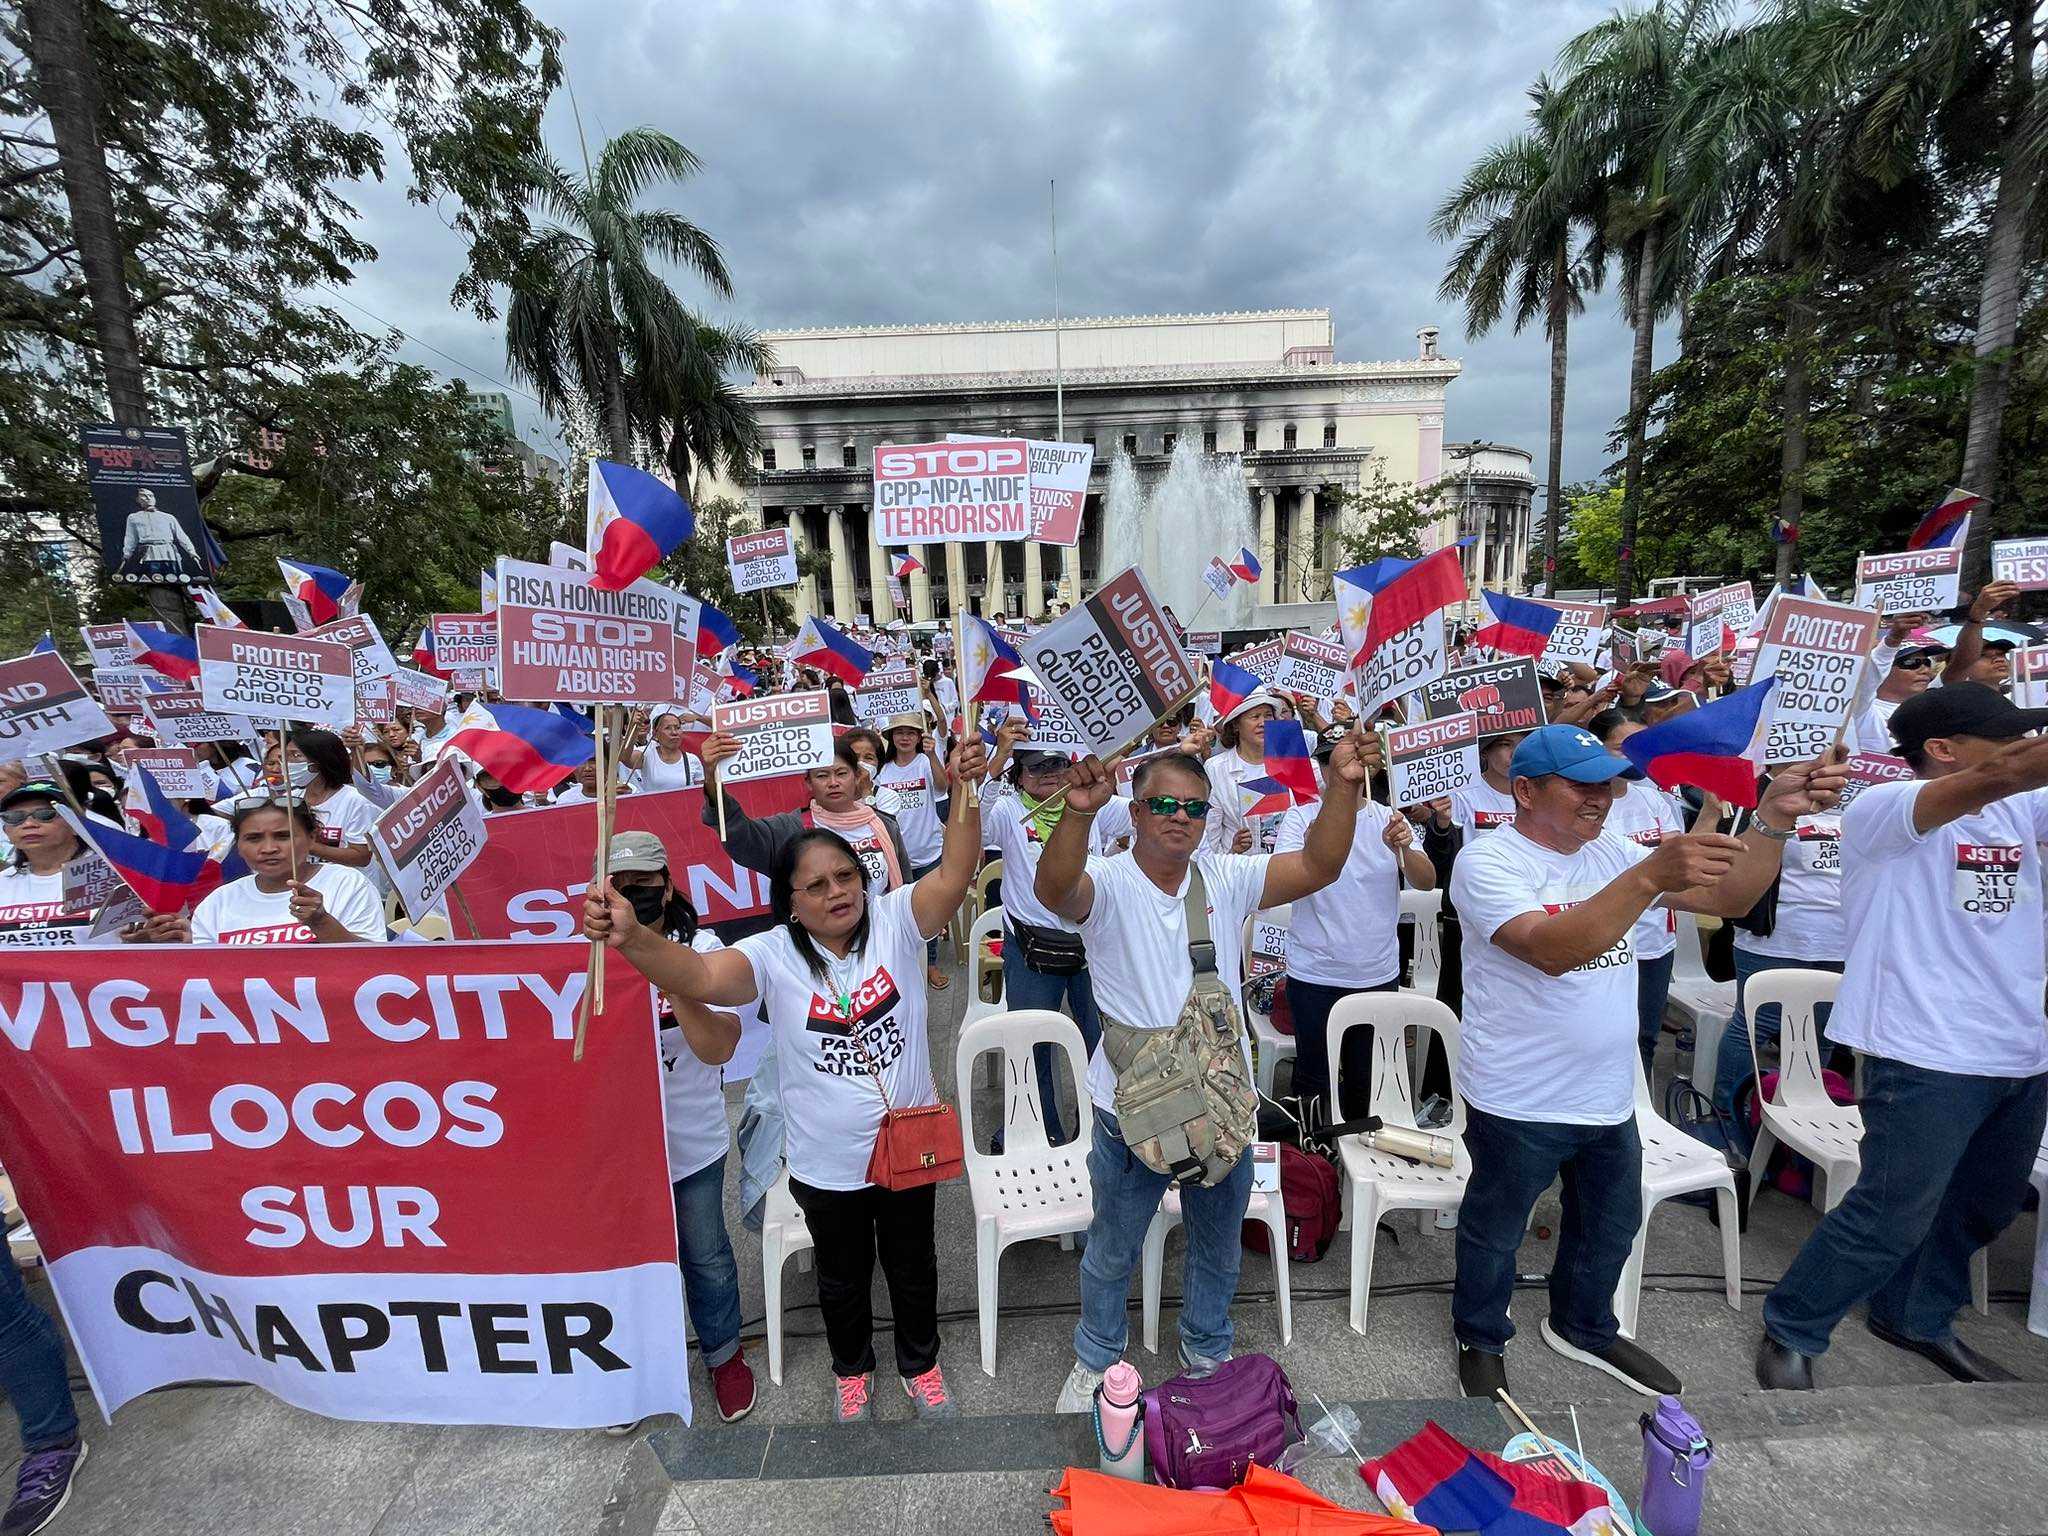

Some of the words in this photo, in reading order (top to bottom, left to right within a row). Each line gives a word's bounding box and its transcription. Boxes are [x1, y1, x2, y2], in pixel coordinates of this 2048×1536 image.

[881, 448, 1022, 477] STOP
[1029, 447, 1087, 464] NTABILITY
[880, 476, 1024, 507] CPP-NPA-NDF
[880, 503, 1024, 538] TERRORISM
[732, 536, 785, 556] JUSTICE
[1996, 545, 2023, 559] RISA
[744, 558, 779, 571] PASTOR
[745, 566, 780, 579] APOLLO
[1864, 554, 1951, 576] JUSTICE
[741, 572, 787, 586] QUIBOLOY
[1874, 578, 1935, 594] PASTOR
[1895, 572, 1916, 580] FOR
[506, 575, 556, 607] RISA
[561, 580, 668, 621] HONTIVEROS
[1722, 600, 1749, 612] STOR
[1722, 608, 1749, 619] OLLO
[92, 630, 127, 641] JUST
[438, 621, 497, 635] STO
[531, 613, 653, 648] STOP
[1782, 613, 1865, 651] PROTECT
[232, 643, 322, 671] PROTECT
[437, 646, 497, 664] CORRUP
[513, 641, 597, 670] HUMAN
[601, 646, 667, 673] RIGHTS
[1111, 591, 1189, 701] JUSTICE
[1235, 645, 1281, 669] PROTECT
[1291, 640, 1347, 664] JUSTICE
[1545, 646, 1592, 657] OLOY
[1119, 649, 1142, 678] FOR
[1293, 661, 1336, 679] PASTOR
[1776, 650, 1856, 675] PASTOR
[237, 666, 323, 685] PASTOR
[557, 669, 636, 695] ABUSES
[860, 671, 912, 688] JUSTICE
[1081, 632, 1142, 716] PASTOR
[1290, 669, 1333, 688] APOLLO
[1428, 665, 1527, 693] PROTECT
[1780, 671, 1847, 694] POLLO
[234, 678, 322, 698] APOLLO
[867, 690, 908, 702] PASTOR
[1036, 649, 1115, 745] QUIBOLOY
[1061, 649, 1125, 727] APOLLO
[1282, 676, 1338, 699] QUIBOLOY
[1429, 690, 1457, 703] OUR
[152, 698, 202, 710] JUSTI
[223, 689, 333, 711] QUIBOLOY
[864, 704, 916, 716] QUIBOLOY
[868, 697, 909, 709] APOLLO
[1777, 691, 1853, 715] IBOLOY
[174, 716, 228, 725] PASTOR
[722, 697, 820, 726] JUSTICE
[174, 729, 240, 739] QUIBOLOY
[179, 723, 231, 731] APOLLO
[741, 727, 810, 747] PASTOR
[760, 721, 784, 731] FOR
[1394, 719, 1471, 752] JUSTICE
[1029, 733, 1084, 744] UIBOL
[1767, 730, 1827, 747] OLLO
[737, 740, 811, 761] APOLLO
[1425, 745, 1444, 756] FOR
[728, 752, 823, 776] QUIBOLOY
[1407, 751, 1463, 775] PASTOR
[1407, 764, 1464, 788] APOLLO
[1399, 774, 1473, 802] QUIBOLOY
[390, 775, 458, 849] JUSTICE
[428, 822, 444, 840] FOR
[417, 817, 464, 870] PASTOR
[424, 830, 467, 883] APOLLO
[421, 835, 477, 901] QUIBOLOY
[227, 926, 317, 944] JUSTIC
[0, 976, 331, 1051] VIGAN
[354, 972, 590, 1043] CITY
[109, 1081, 504, 1155] ILOCOS
[240, 1185, 448, 1249] SUR
[113, 1268, 632, 1375] CHAPTER
